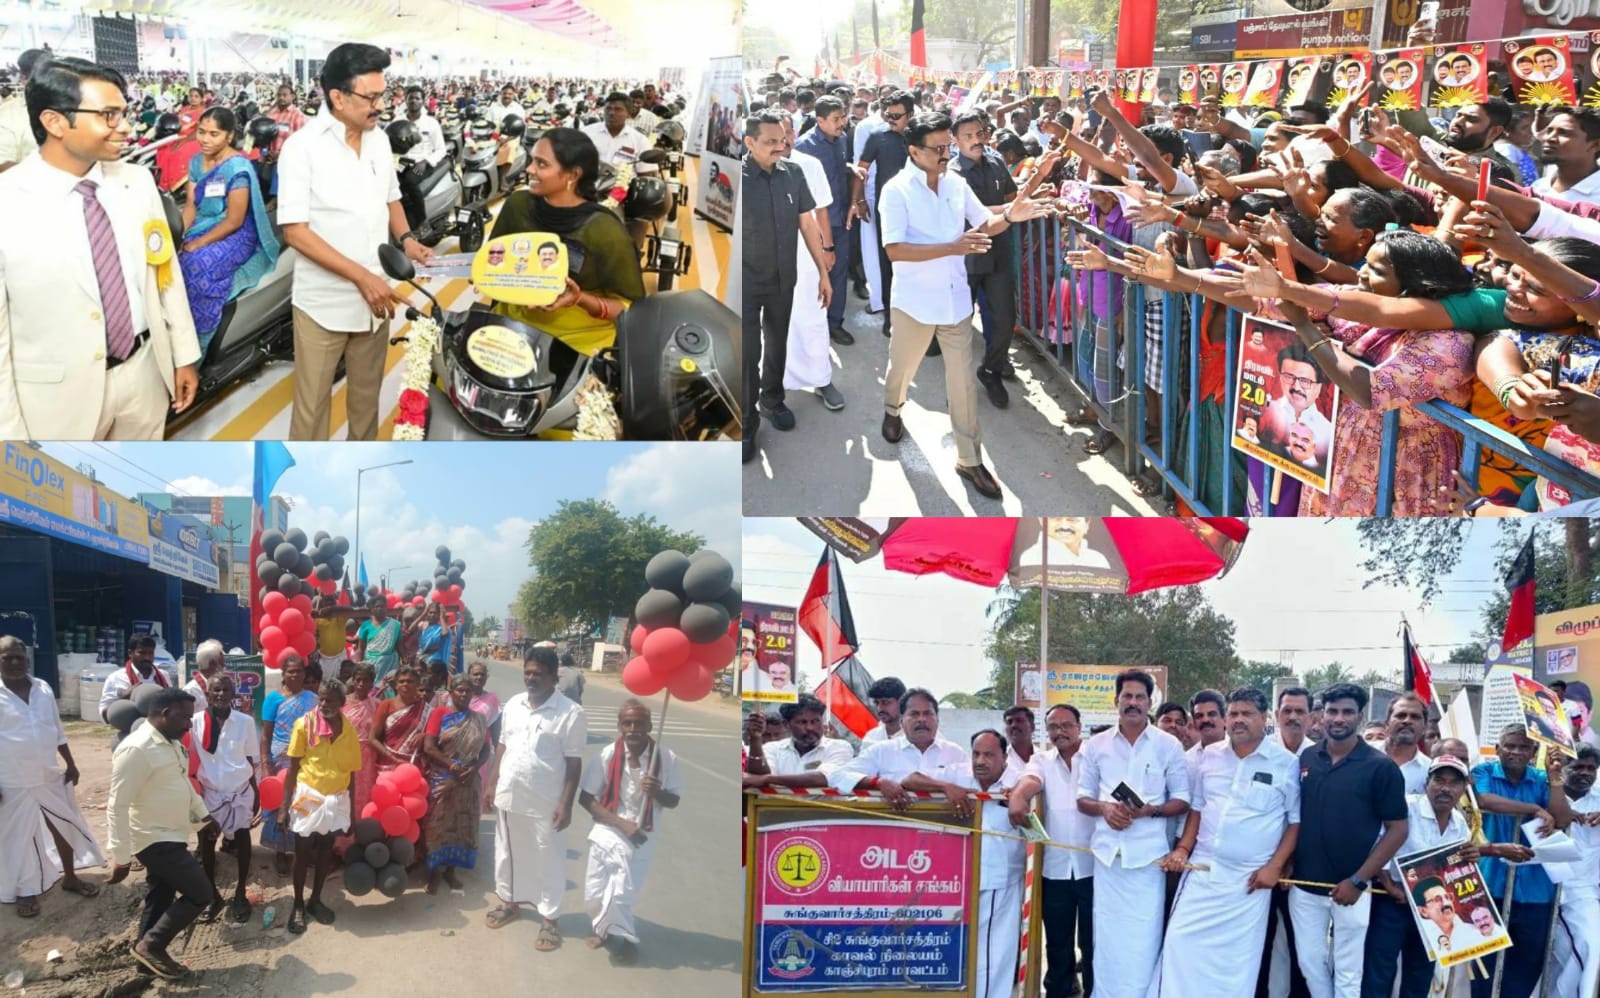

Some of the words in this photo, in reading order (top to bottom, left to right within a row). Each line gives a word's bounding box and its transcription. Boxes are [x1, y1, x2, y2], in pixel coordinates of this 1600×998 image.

[1199, 34, 1211, 44] SBI
[1301, 33, 1332, 47] punjab
[1334, 32, 1371, 43] nationa
[1555, 616, 1600, 635] விழுப்
[860, 846, 931, 874] அடகு
[828, 874, 912, 894] வியாபாரிகள்
[916, 875, 961, 894] சங்கம்
[831, 948, 877, 961] காவல்
[880, 948, 943, 962] நிலையம்
[824, 963, 889, 978] காஞ்சிபுரம்
[892, 963, 949, 976] மாவட்டம்
